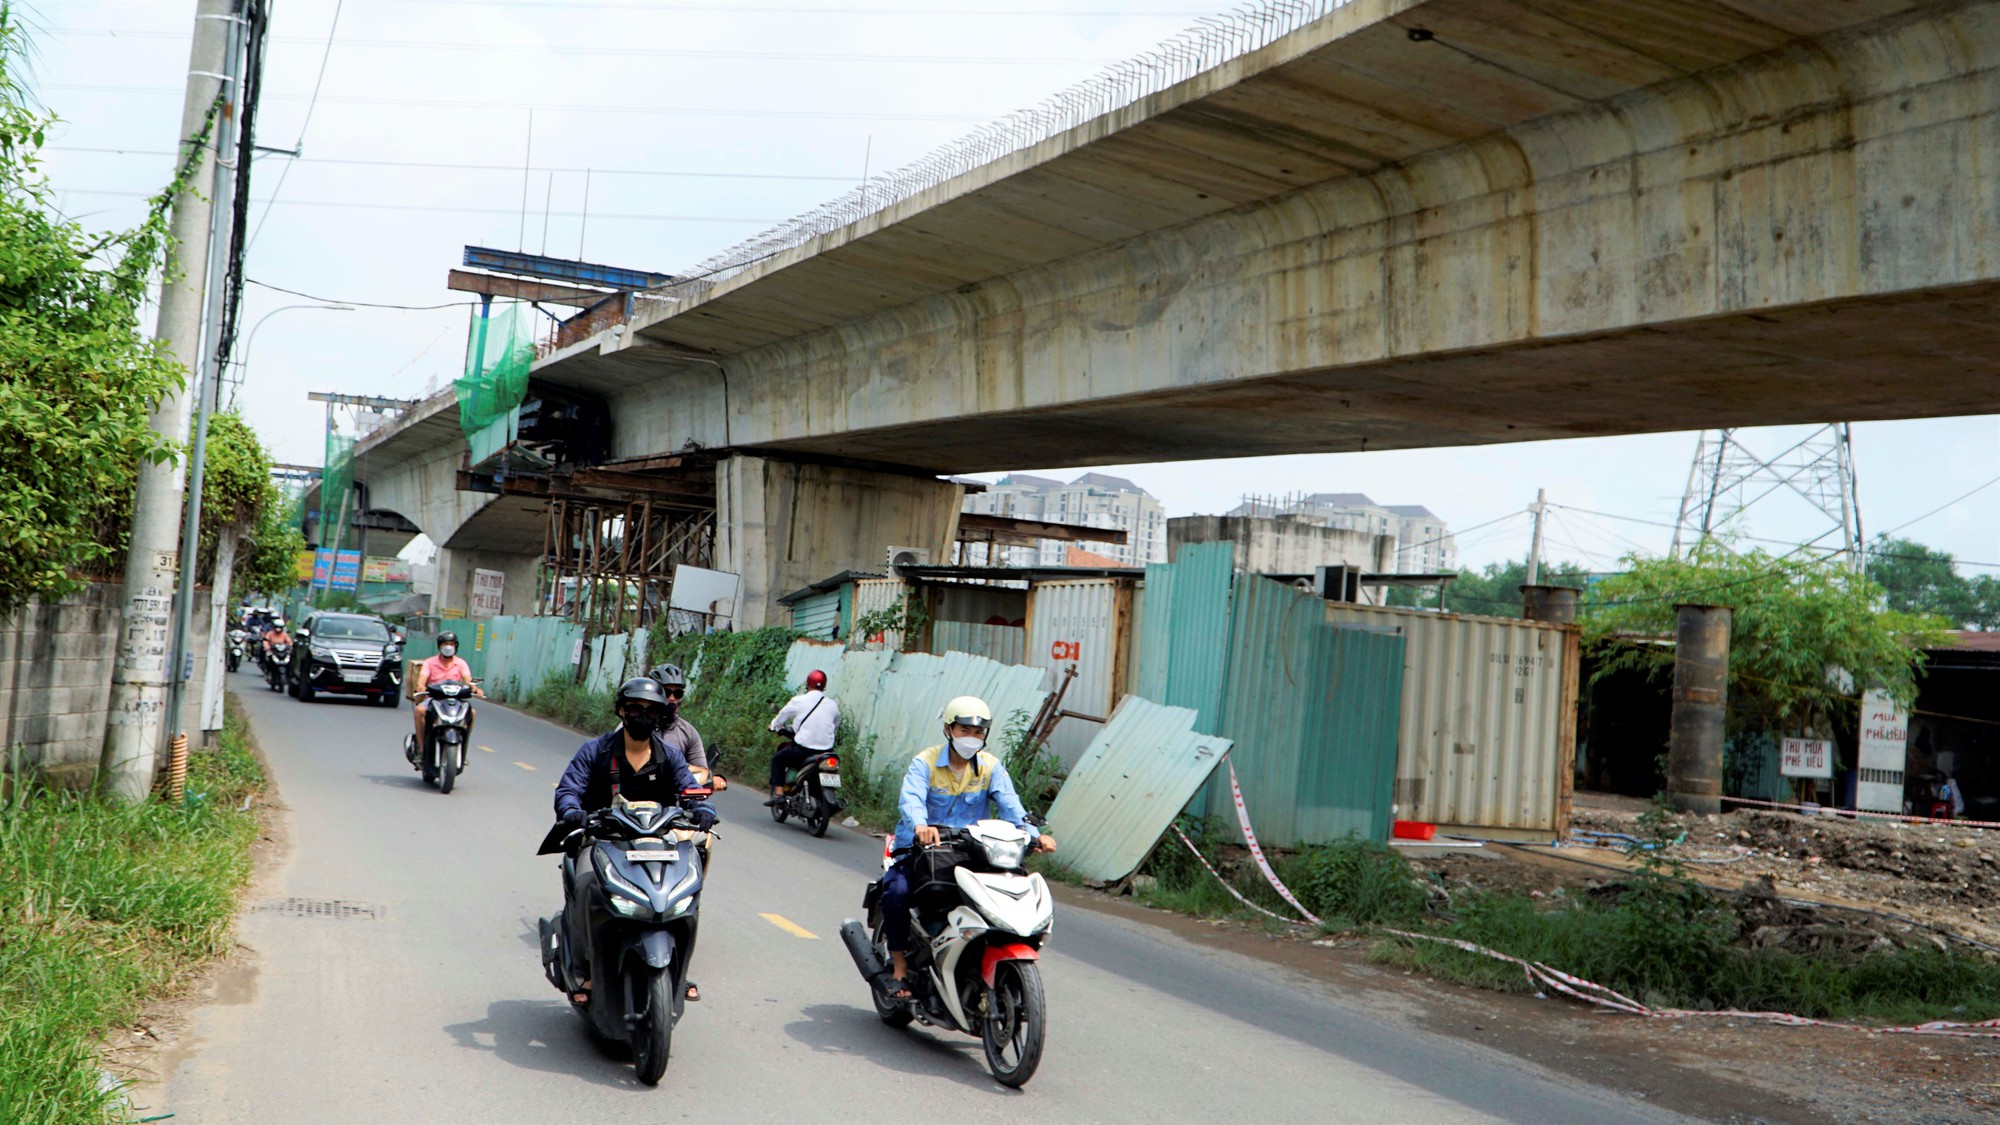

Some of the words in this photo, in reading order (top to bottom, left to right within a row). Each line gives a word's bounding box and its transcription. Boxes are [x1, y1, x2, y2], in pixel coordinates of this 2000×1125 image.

[160, 556, 172, 567] 31
[1785, 741, 1800, 754] THU
[1805, 743, 1823, 755] MUA
